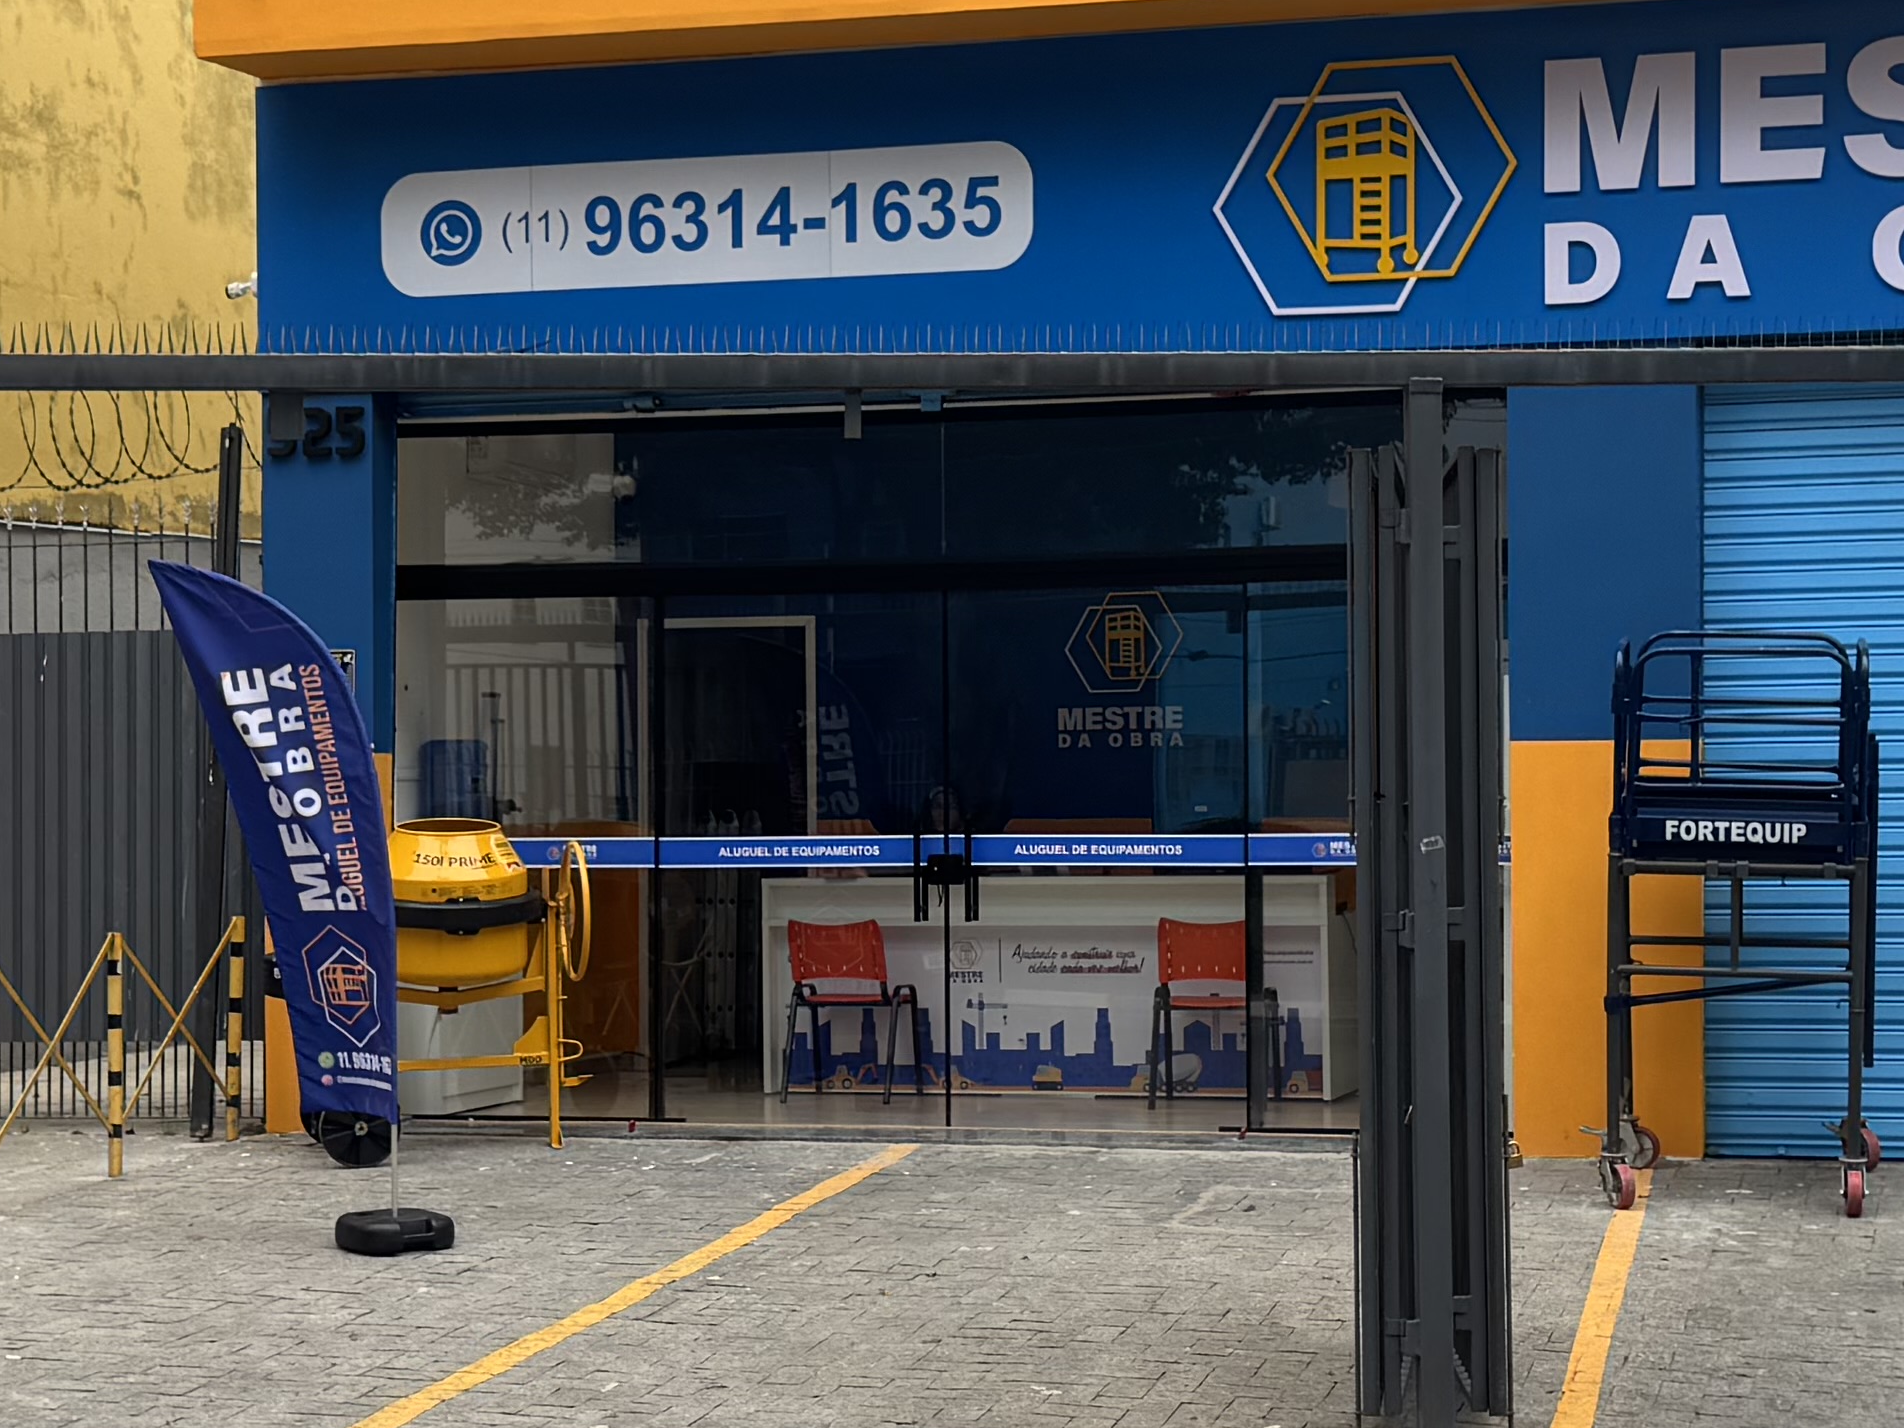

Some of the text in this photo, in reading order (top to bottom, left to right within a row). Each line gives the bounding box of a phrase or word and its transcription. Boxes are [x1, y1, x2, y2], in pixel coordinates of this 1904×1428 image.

[500, 174, 1002, 259] (11) 96314-1635
[1543, 214, 1751, 305] DA
[1057, 706, 1184, 731] MESTRE
[269, 663, 322, 817] OBRA
[299, 664, 349, 805] EQUIPAMENTOS
[1058, 732, 1184, 749] DA OBRA
[330, 808, 355, 834] DE
[1665, 820, 1807, 844] FORTEQUIP
[719, 845, 880, 857] ALUGUEL DE EQUIPAMENTOS
[1014, 843, 1183, 855] ALUGUEL DE EQUIPAMENTOS
[335, 837, 367, 911] UGUEL
